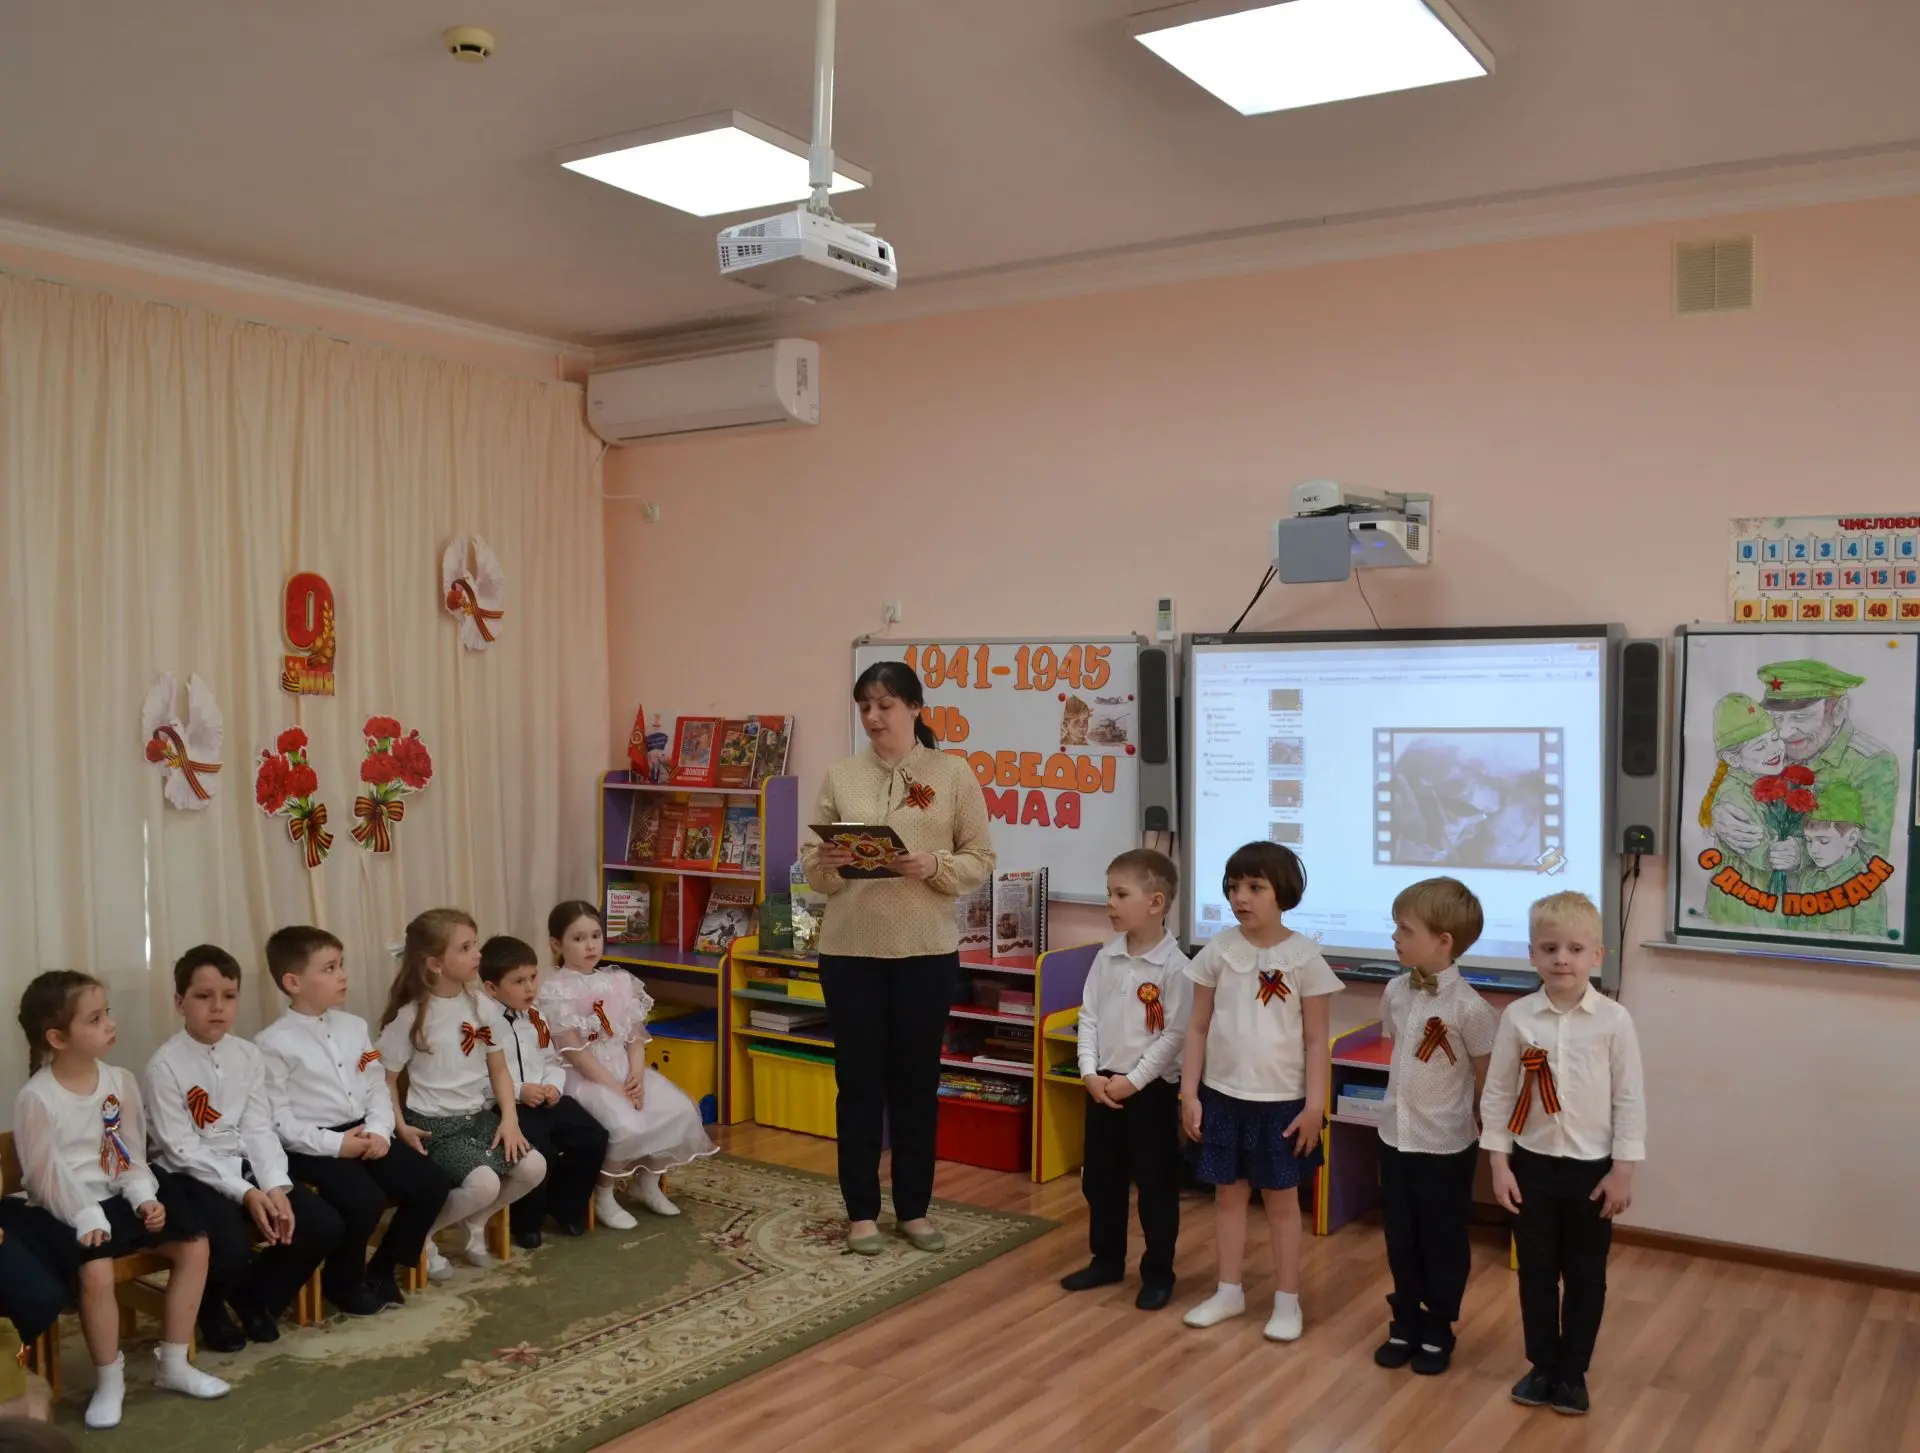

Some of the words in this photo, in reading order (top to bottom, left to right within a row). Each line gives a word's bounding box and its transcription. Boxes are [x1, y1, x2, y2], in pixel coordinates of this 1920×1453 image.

[1302, 495, 1320, 503] NEC
[1742, 544, 1753, 559] 0
[1768, 544, 1777, 558] 1
[1795, 543, 1806, 558] 2
[1820, 542, 1831, 557] 3
[1847, 542, 1858, 557] 4
[1873, 541, 1884, 556] 5
[1901, 541, 1912, 556] 6
[1764, 572, 1779, 587] 11
[1789, 572, 1807, 586] 12
[1815, 571, 1833, 586] 13
[1844, 571, 1861, 585] 14
[1870, 570, 1888, 584] 15
[1898, 570, 1917, 584] 16
[284, 572, 335, 676] 9
[1742, 604, 1753, 618] 0
[1771, 604, 1788, 618] 10
[1802, 604, 1822, 618] 20
[1834, 603, 1855, 617] 30
[1867, 603, 1888, 617] 40
[1901, 603, 1920, 617] 50
[904, 644, 1111, 690] 1941-1945
[920, 705, 970, 743] НЬ
[943, 749, 1117, 793] ОБЕДЫ
[982, 787, 1080, 829] МАЯ
[1698, 848, 1722, 870] С
